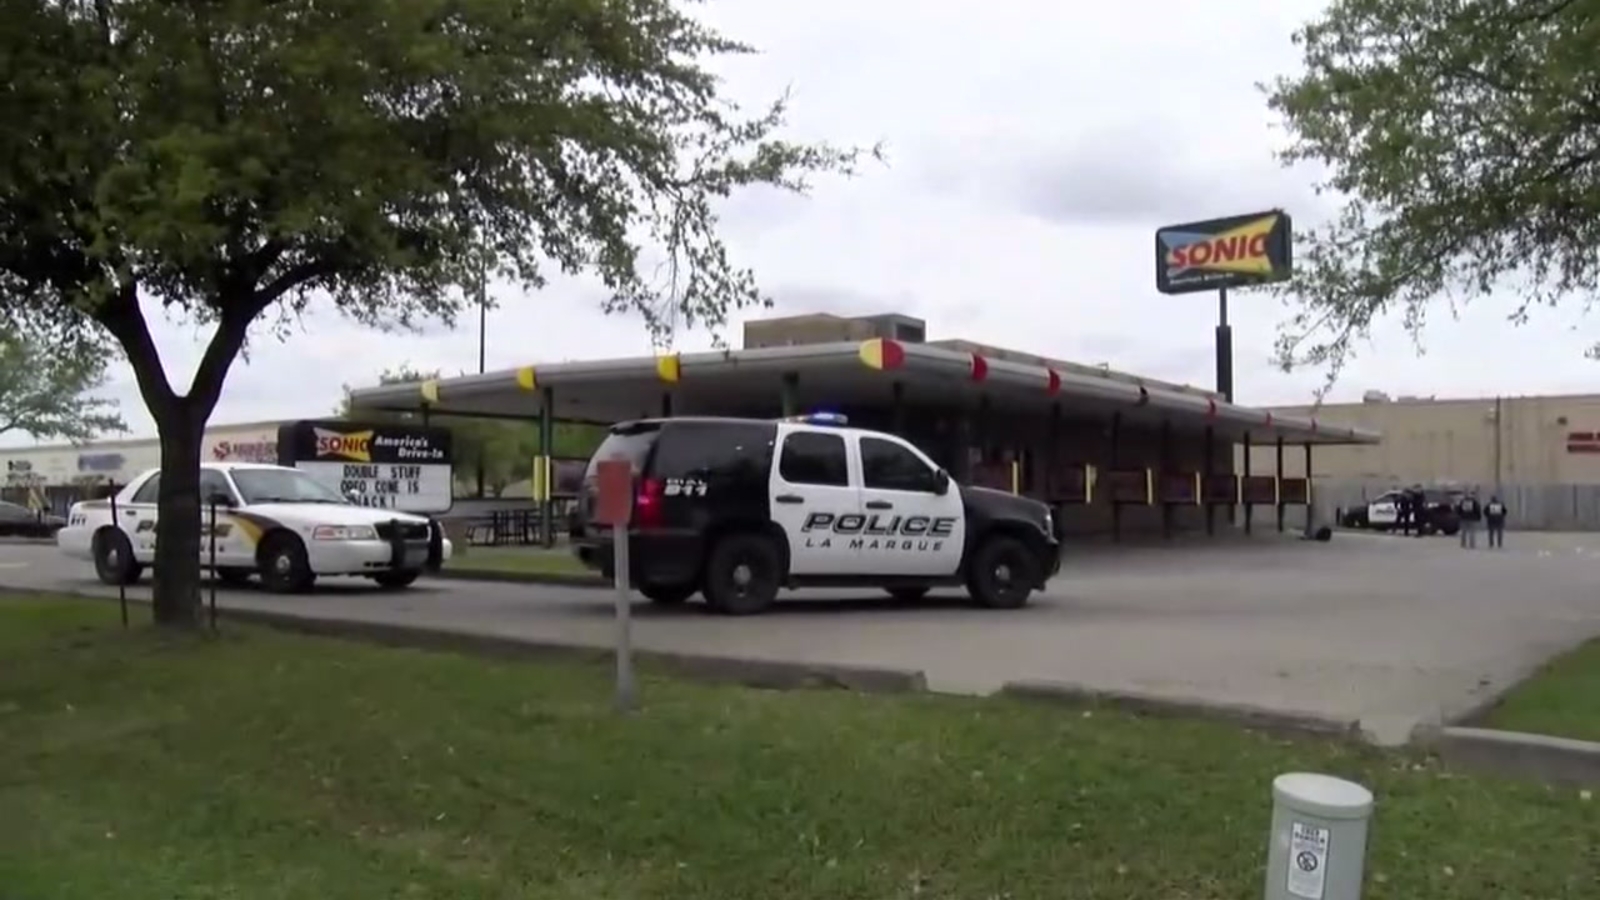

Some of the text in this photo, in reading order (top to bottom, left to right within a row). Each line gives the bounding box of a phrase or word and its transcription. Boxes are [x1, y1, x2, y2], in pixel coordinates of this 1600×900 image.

[1171, 232, 1268, 268] SONIC
[319, 437, 369, 453] SONIC
[375, 435, 428, 447] America's
[398, 447, 444, 458] Drive-In
[343, 464, 421, 479] DOUBLE STUFF
[374, 480, 399, 495] CONE
[407, 480, 420, 494] IS
[664, 483, 708, 496] 911
[801, 512, 960, 538] POLICE
[805, 538, 943, 551] LA MARQUE
